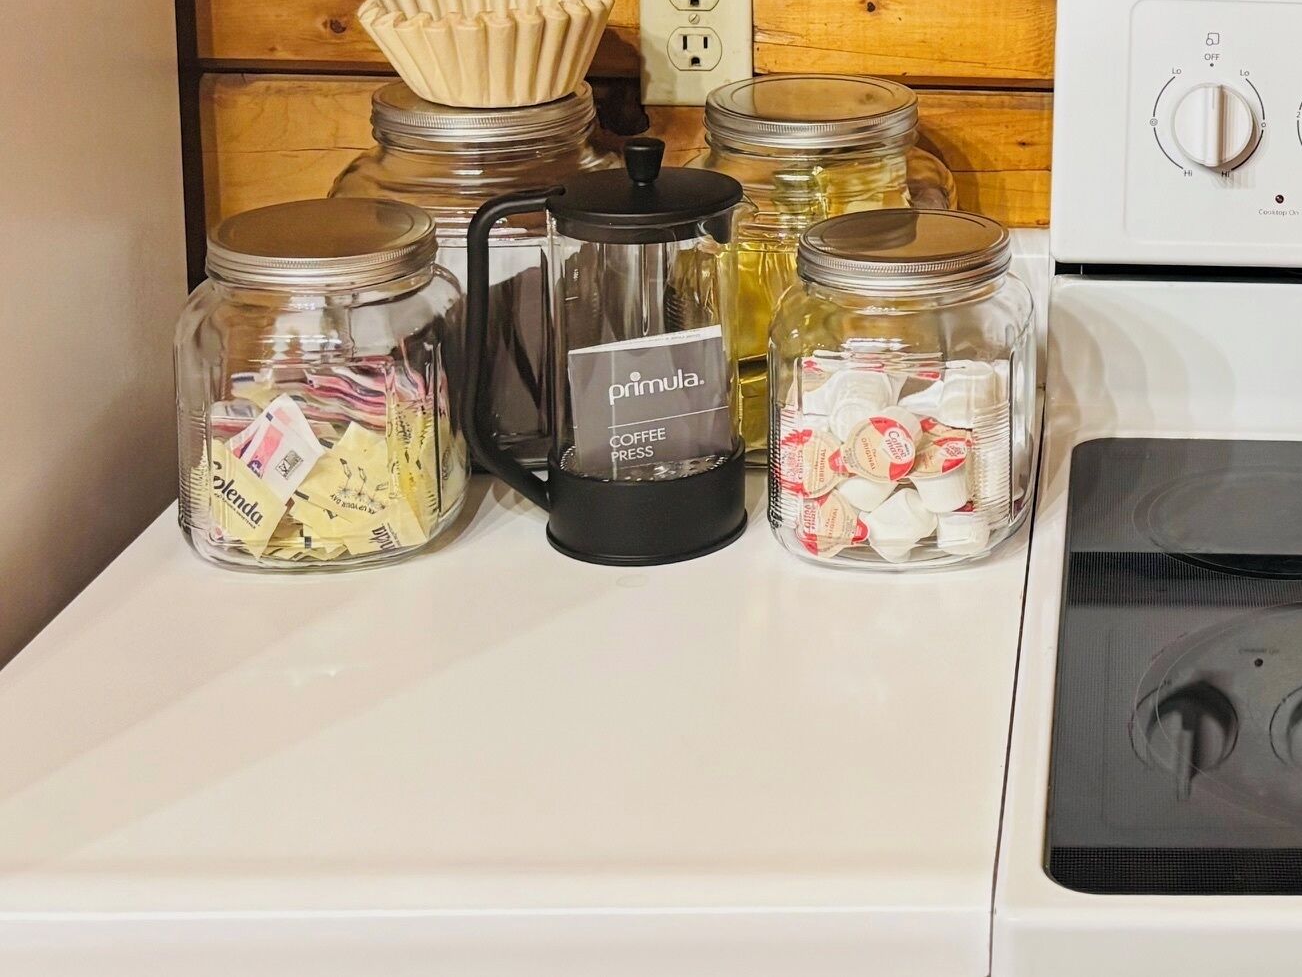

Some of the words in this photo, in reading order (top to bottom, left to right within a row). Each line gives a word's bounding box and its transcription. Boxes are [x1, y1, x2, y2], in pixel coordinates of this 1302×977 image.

[1204, 53, 1220, 61] OFF
[1172, 67, 1182, 75] Lo
[1240, 69, 1250, 77] Lo
[1184, 169, 1193, 177] Hi
[1221, 170, 1230, 178] Hi
[609, 427, 666, 448] COFFEE
[610, 446, 654, 462] PRESS
[861, 437, 876, 470] ORIGINAL
